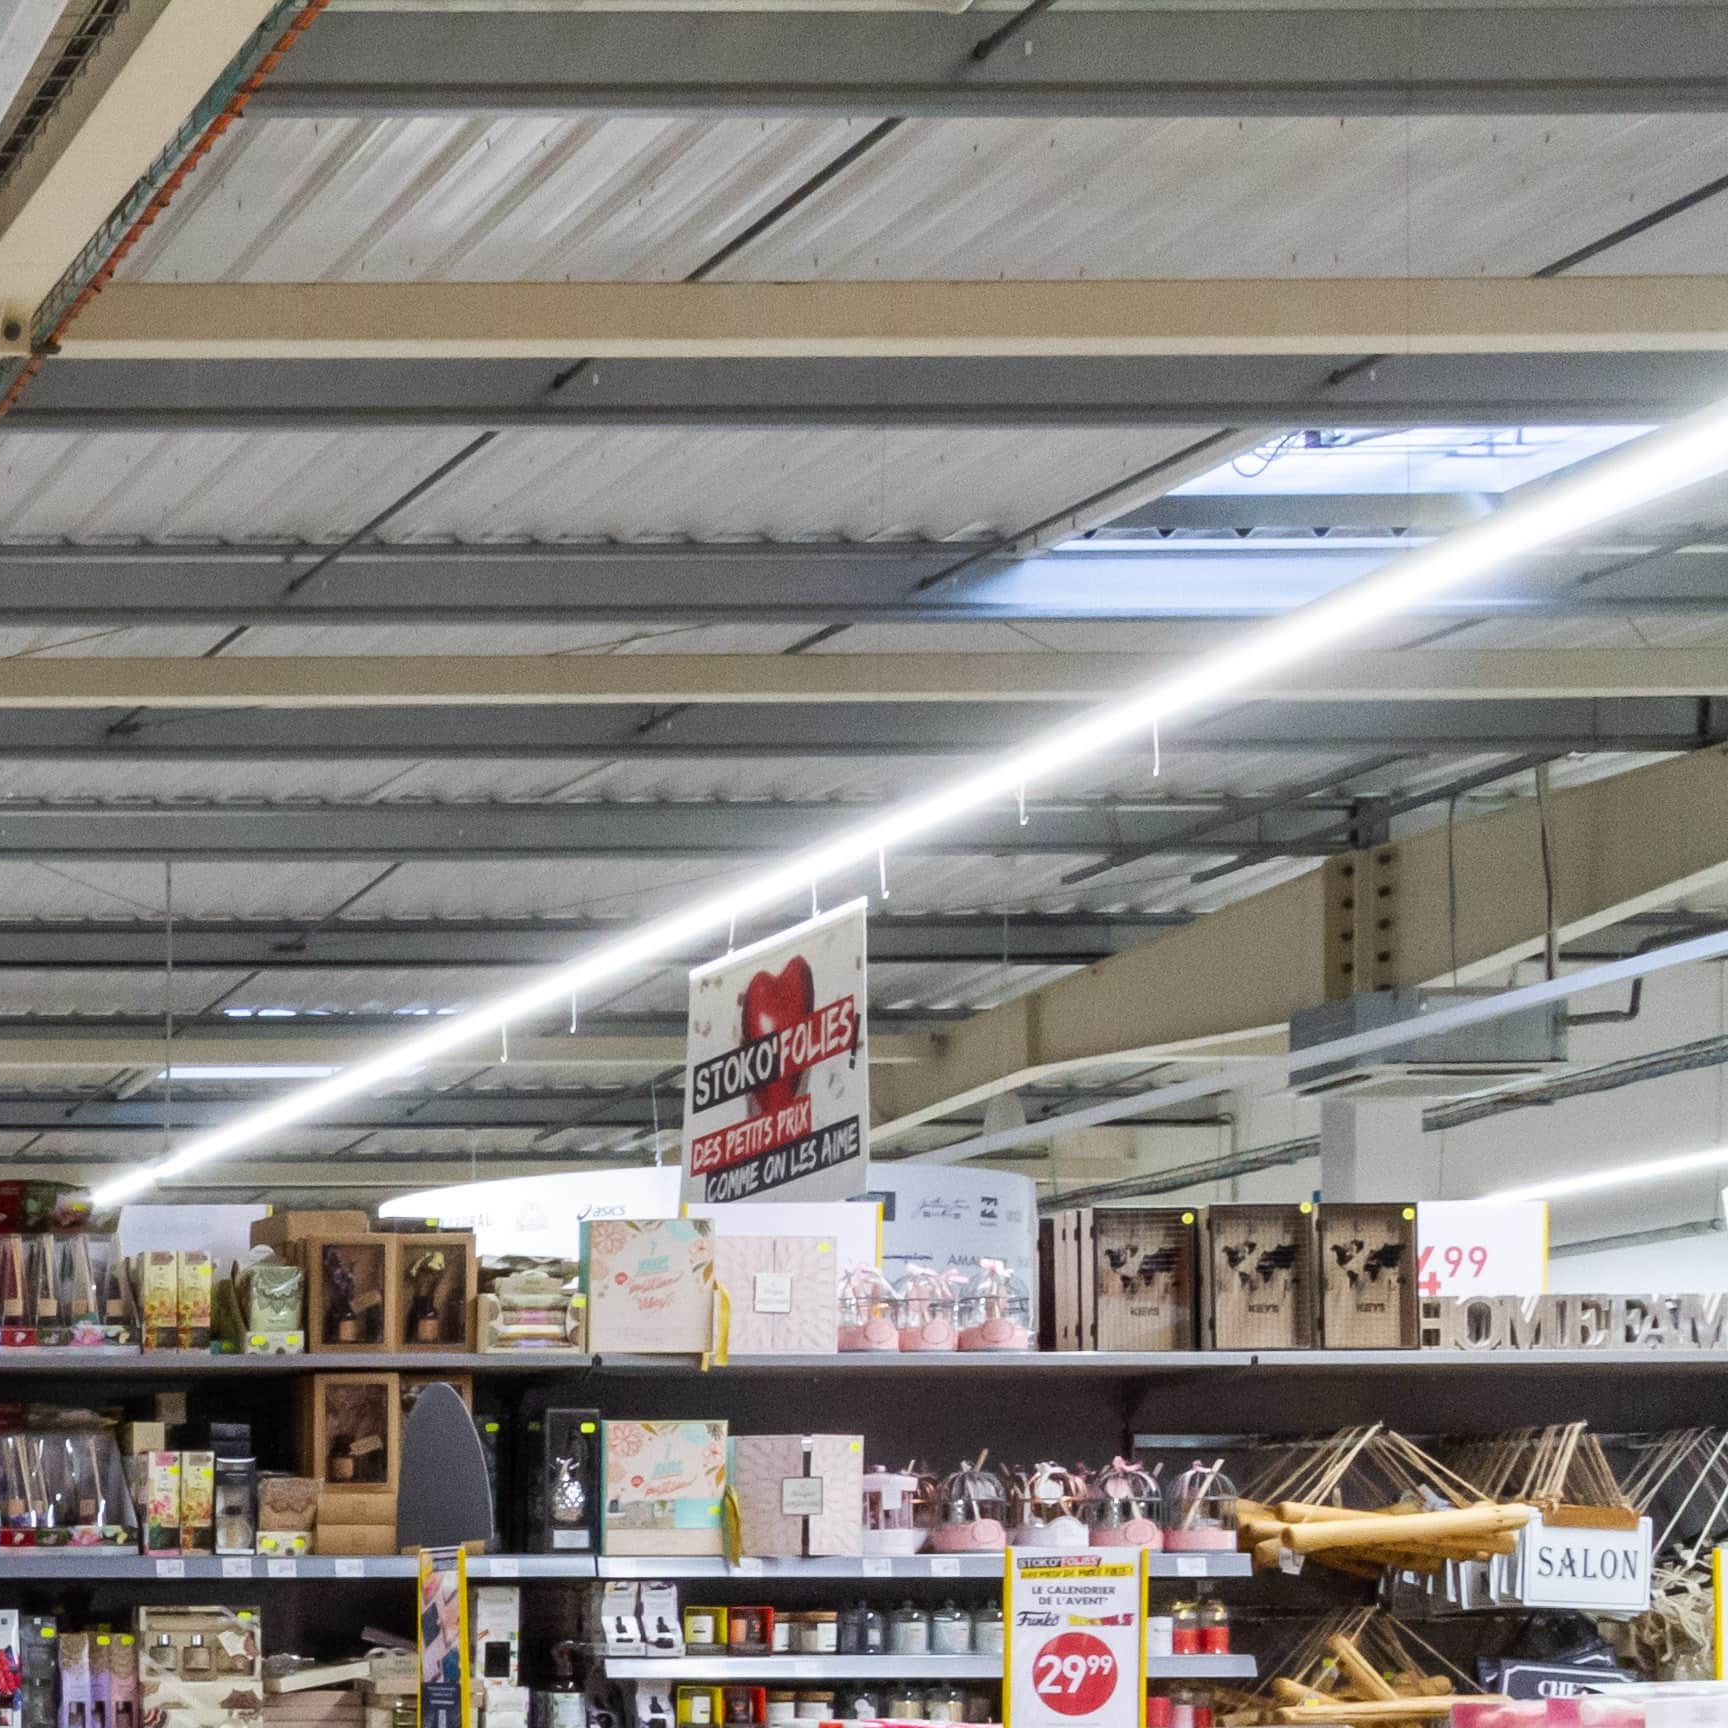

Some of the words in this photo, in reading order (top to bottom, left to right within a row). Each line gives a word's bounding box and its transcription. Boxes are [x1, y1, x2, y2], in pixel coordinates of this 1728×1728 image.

[694, 1135, 721, 1170] DES
[726, 1116, 772, 1158] PETITS
[777, 1102, 810, 1142] PRIX
[707, 1167, 759, 1202] COMME
[763, 1155, 786, 1183] ON
[791, 1142, 817, 1174] LES
[821, 1122, 858, 1164] AIME
[1130, 1306, 1160, 1317] KEYS
[1248, 1304, 1279, 1314] KEYS
[1356, 1303, 1386, 1313] KEYS
[1537, 1546, 1639, 1580] SALON
[1032, 1587, 1045, 1595] LE
[1047, 1586, 1116, 1595] CALENDRIER
[1039, 1597, 1054, 1605] DE
[1017, 1611, 1059, 1626] Funko
